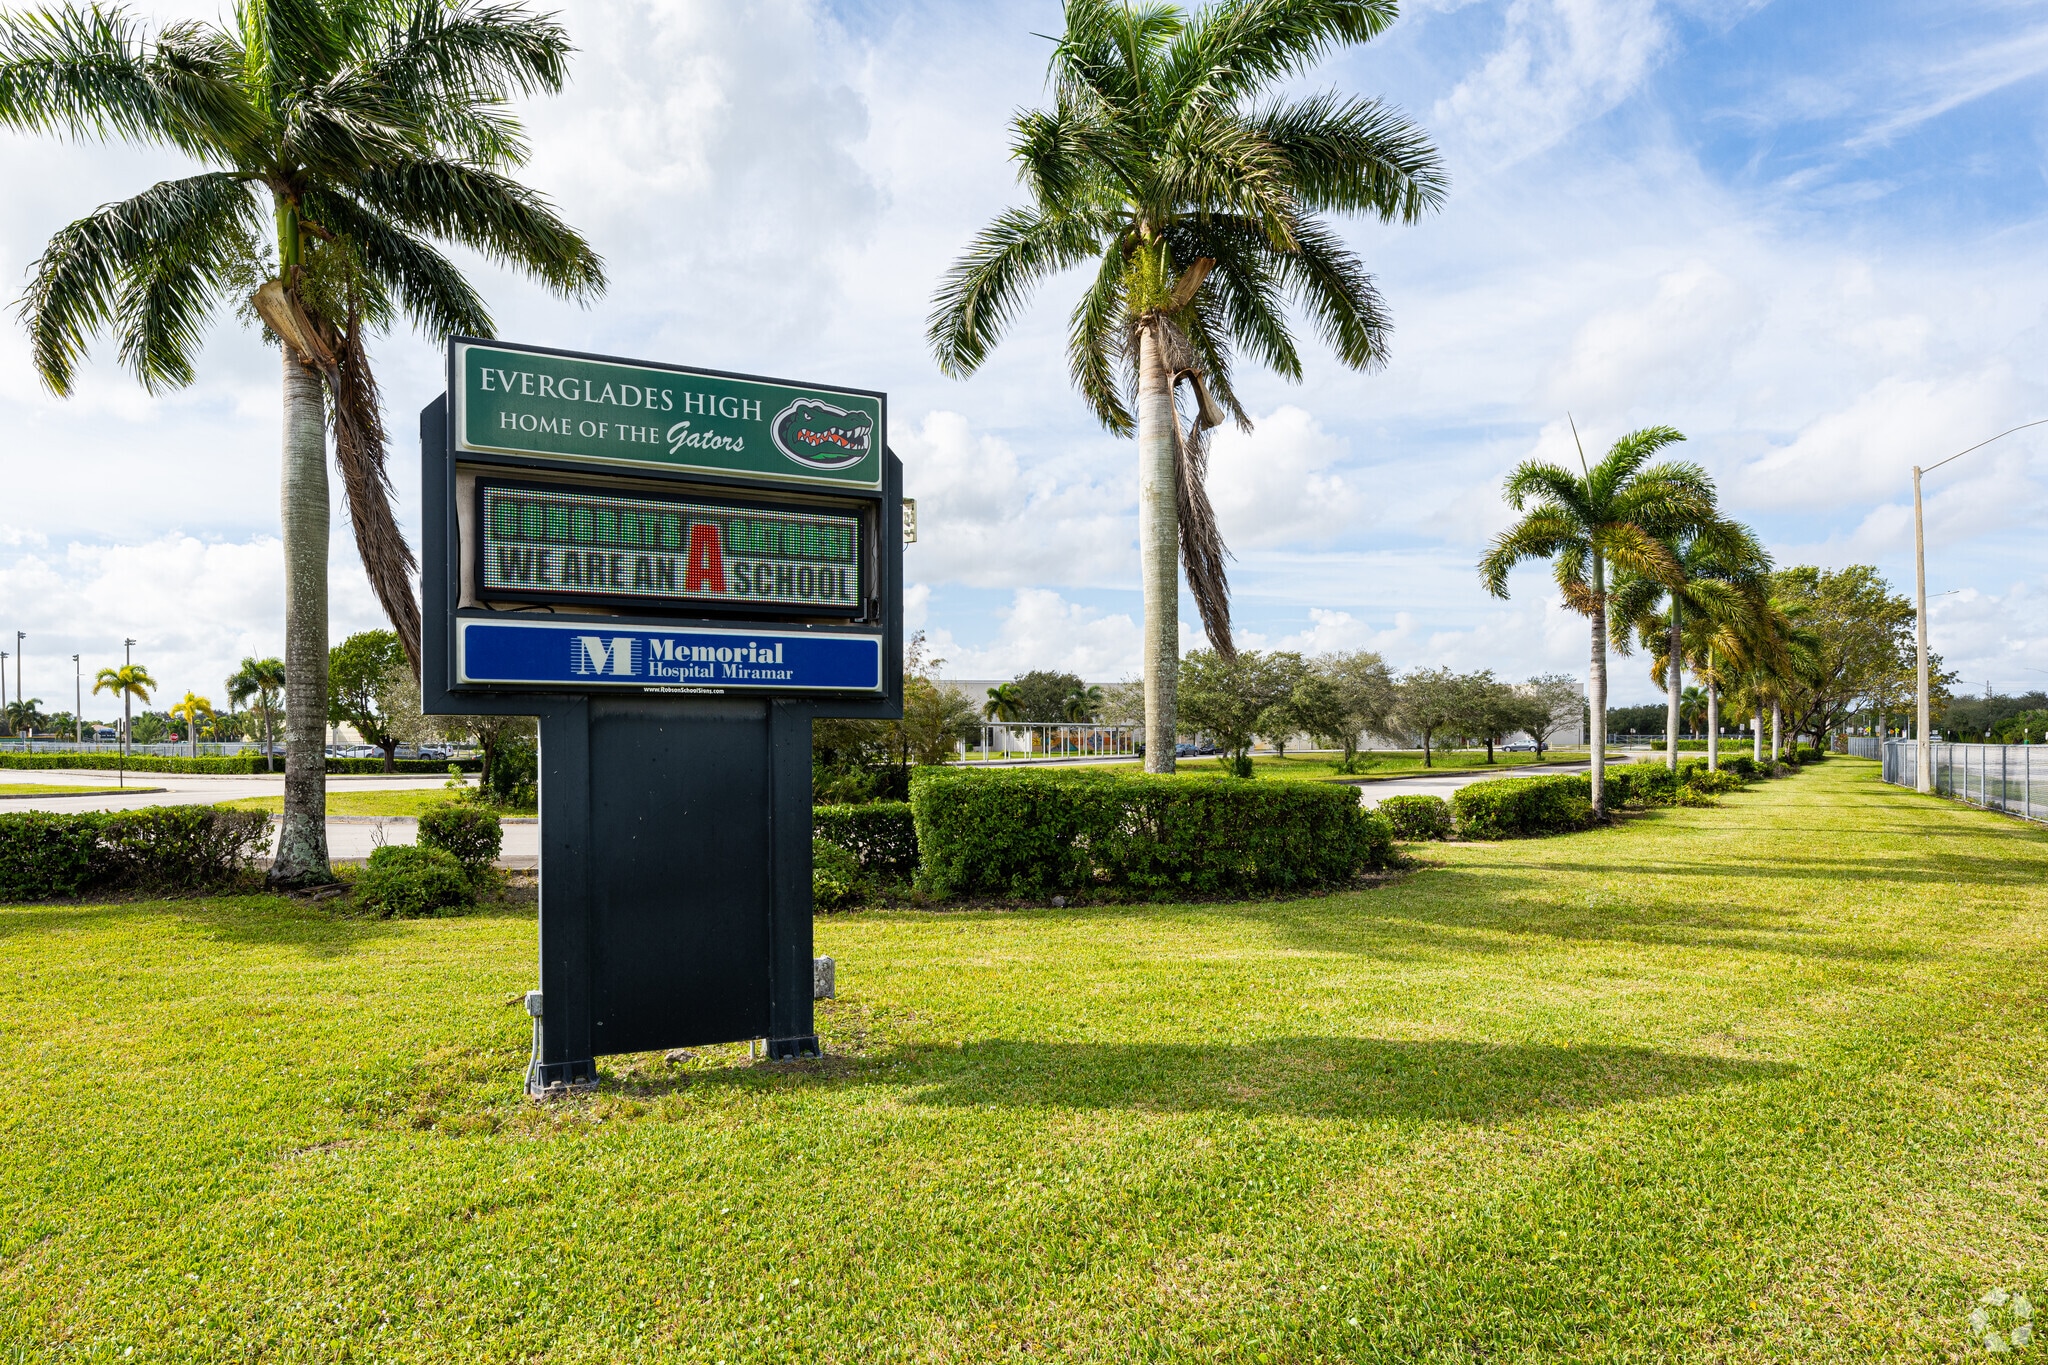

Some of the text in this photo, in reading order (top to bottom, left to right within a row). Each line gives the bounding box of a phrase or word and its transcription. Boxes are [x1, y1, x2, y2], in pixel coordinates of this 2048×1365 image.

[480, 367, 763, 421] EVERGLADES HIGH
[500, 411, 745, 455] HOME OF THE Gators
[498, 522, 849, 599] WE ARE AN A SCHOOL
[648, 638, 784, 664] Memorial
[648, 661, 794, 682] Hospital Miramar
